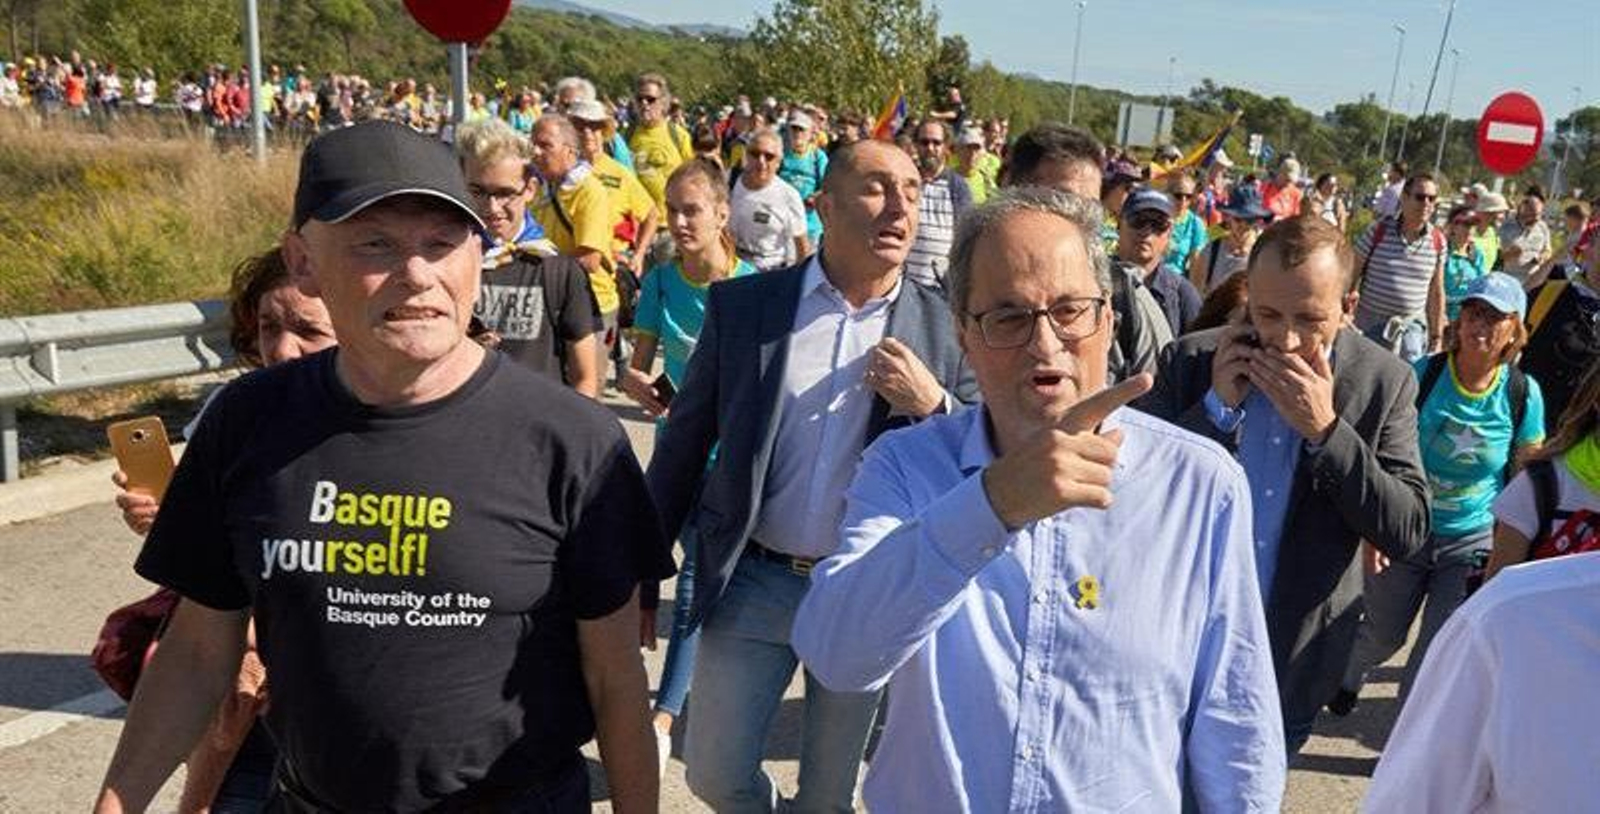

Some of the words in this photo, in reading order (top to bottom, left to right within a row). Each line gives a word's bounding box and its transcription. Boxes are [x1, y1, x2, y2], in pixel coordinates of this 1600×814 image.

[309, 480, 452, 531] Basque
[261, 533, 428, 580] yourself!
[327, 587, 426, 610] University
[431, 591, 452, 608] of
[458, 592, 491, 609] the
[327, 606, 400, 628] Basque
[405, 610, 487, 627] Country
